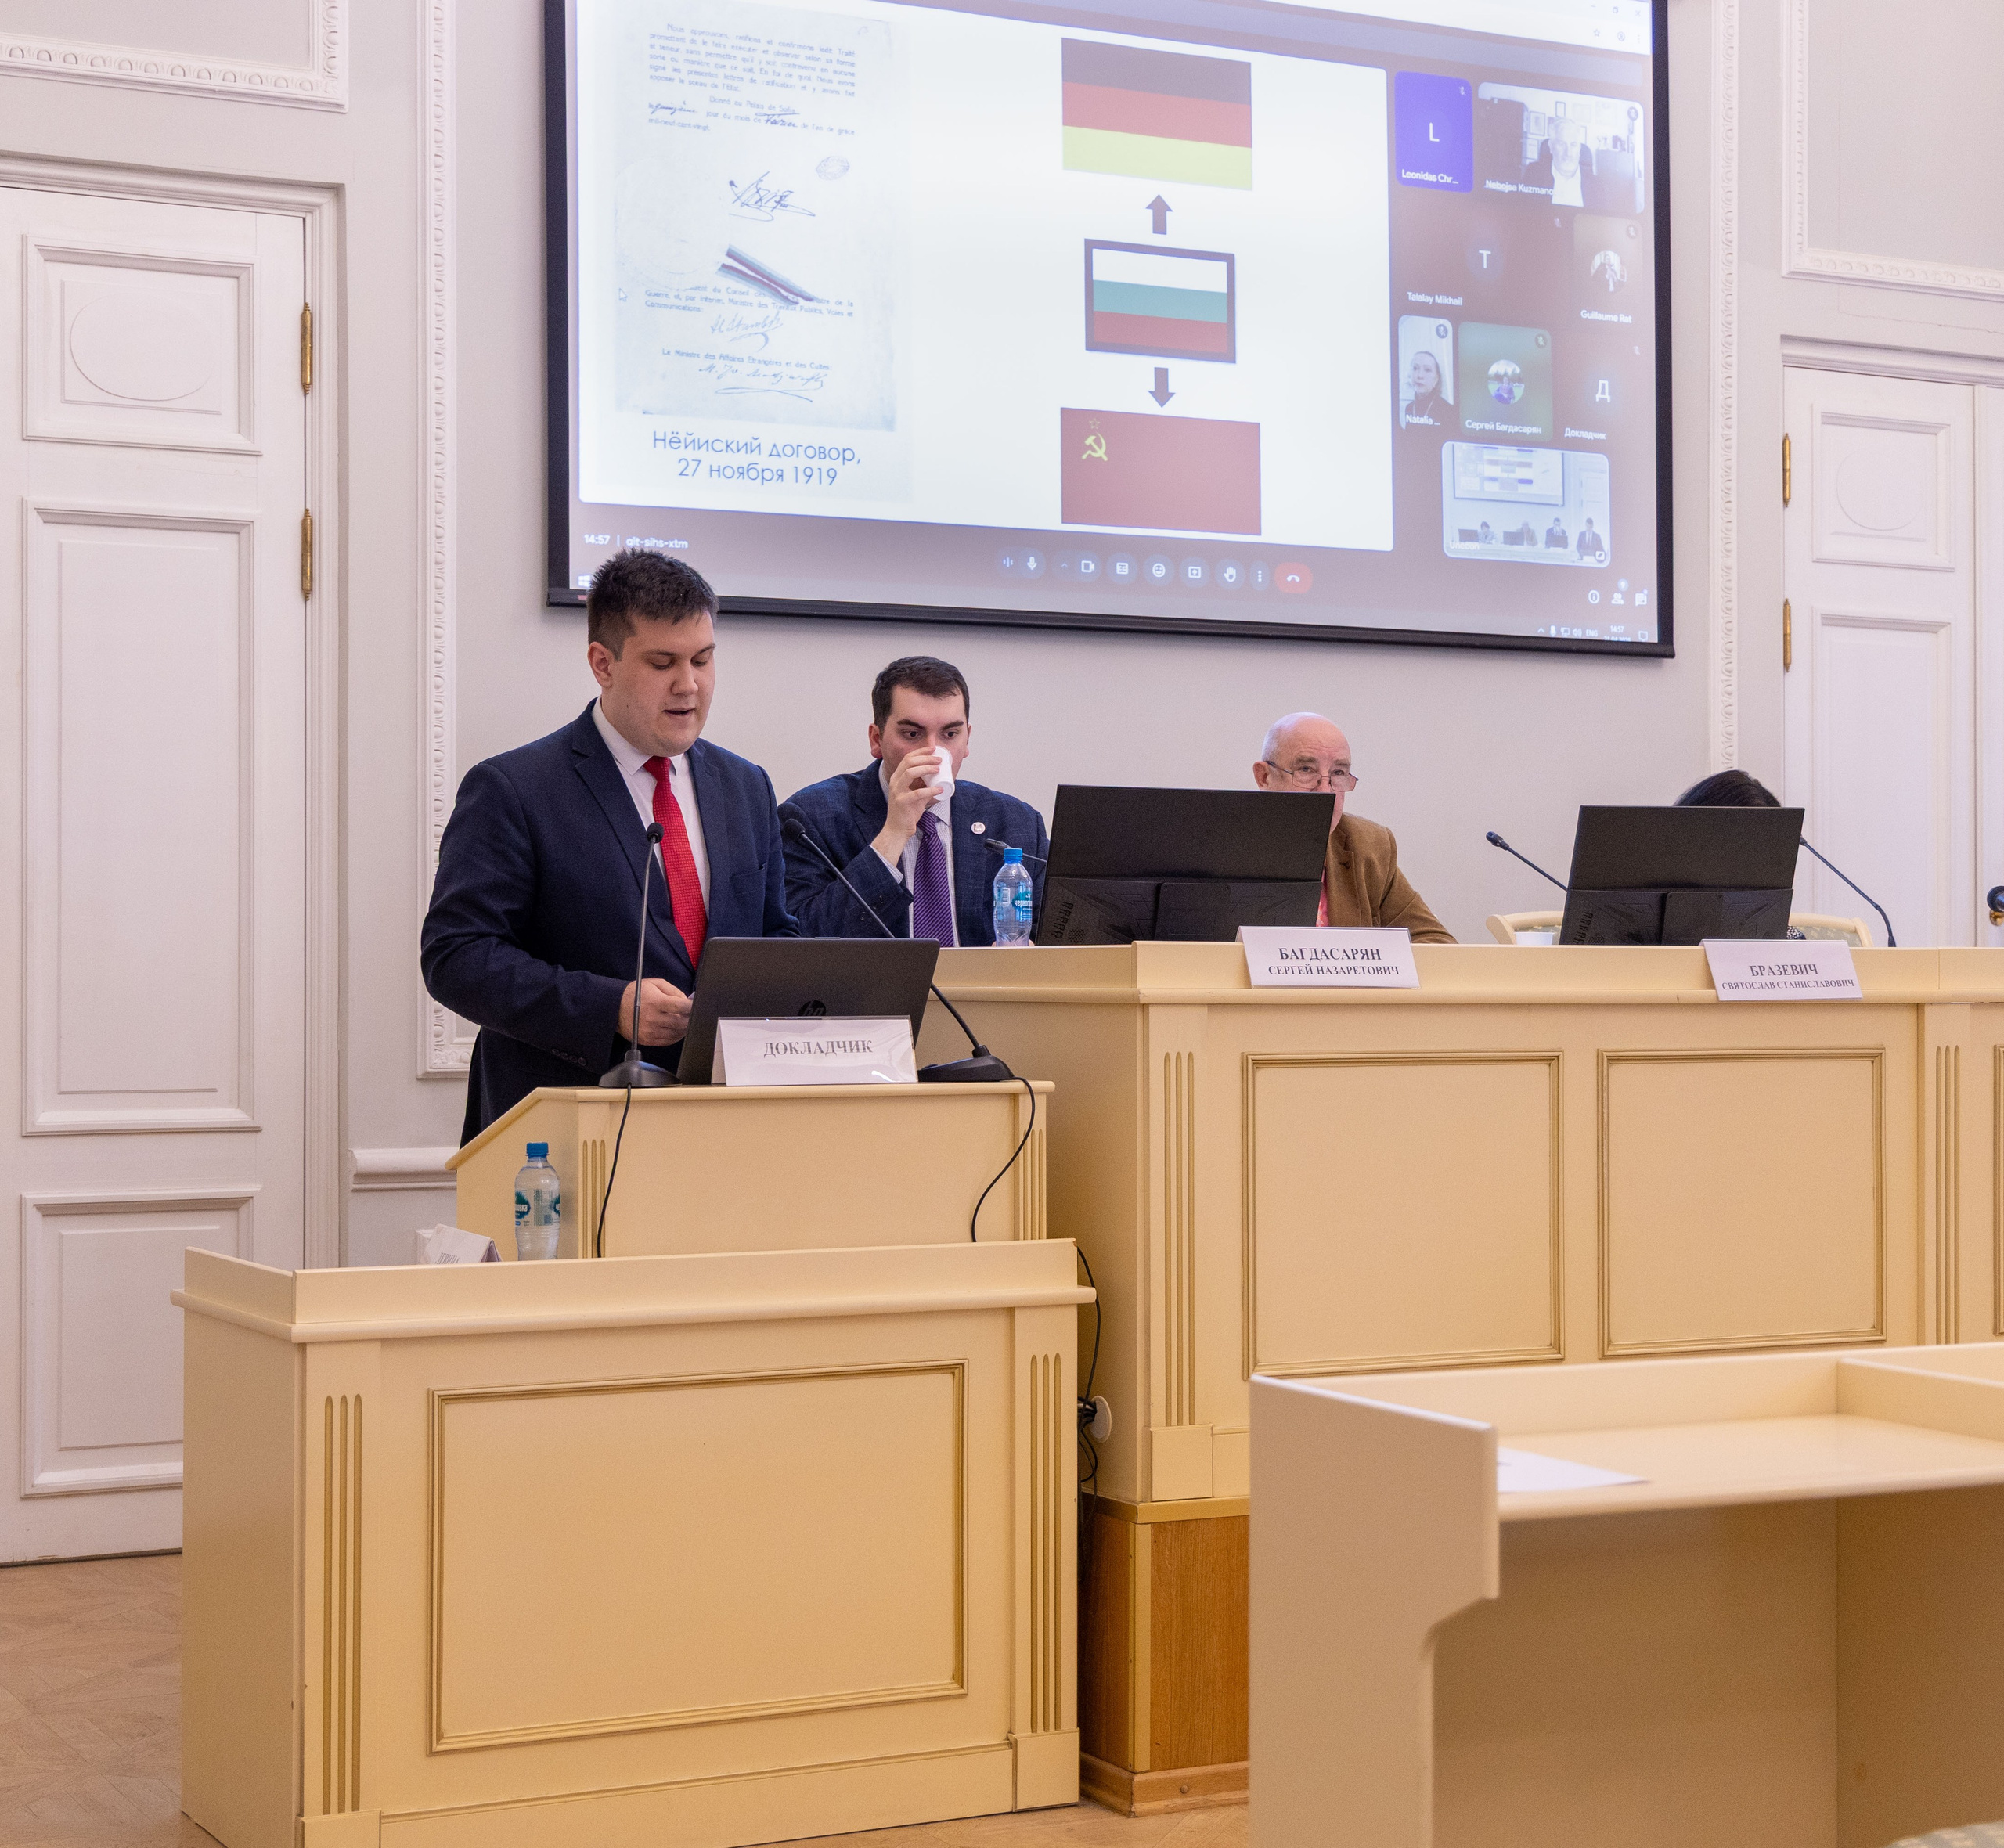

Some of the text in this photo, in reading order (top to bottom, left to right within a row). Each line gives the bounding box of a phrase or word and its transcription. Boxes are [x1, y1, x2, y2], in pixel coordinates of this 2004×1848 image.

[1429, 122, 1440, 142] L
[1401, 169, 1437, 183] Leonidas
[1479, 250, 1491, 269] T
[1407, 291, 1463, 307] Talalay Mikhail
[1580, 309, 1633, 323] Guillaume Rat
[1595, 380, 1610, 403] Д
[1406, 414, 1433, 427] Natalia
[1465, 419, 1542, 434] Сергей Багдасарян
[1564, 427, 1607, 440] Докладчик
[653, 431, 862, 466] Нёйиский договор,
[678, 458, 837, 486] 27 ноября 1919
[585, 534, 610, 545] 14:57
[1278, 947, 1382, 961] БАГДАСАРЯН
[1268, 964, 1400, 975] СЕРГЕЙ НАЗАРЕТОВИЧ
[1749, 964, 1819, 977] БРАЗЕВИЧ
[1722, 979, 1855, 990] СВЯТОСЛАВ СТАНИСЛАВОВИЧ
[764, 1039, 873, 1058] ДОКЛАДЧИК
